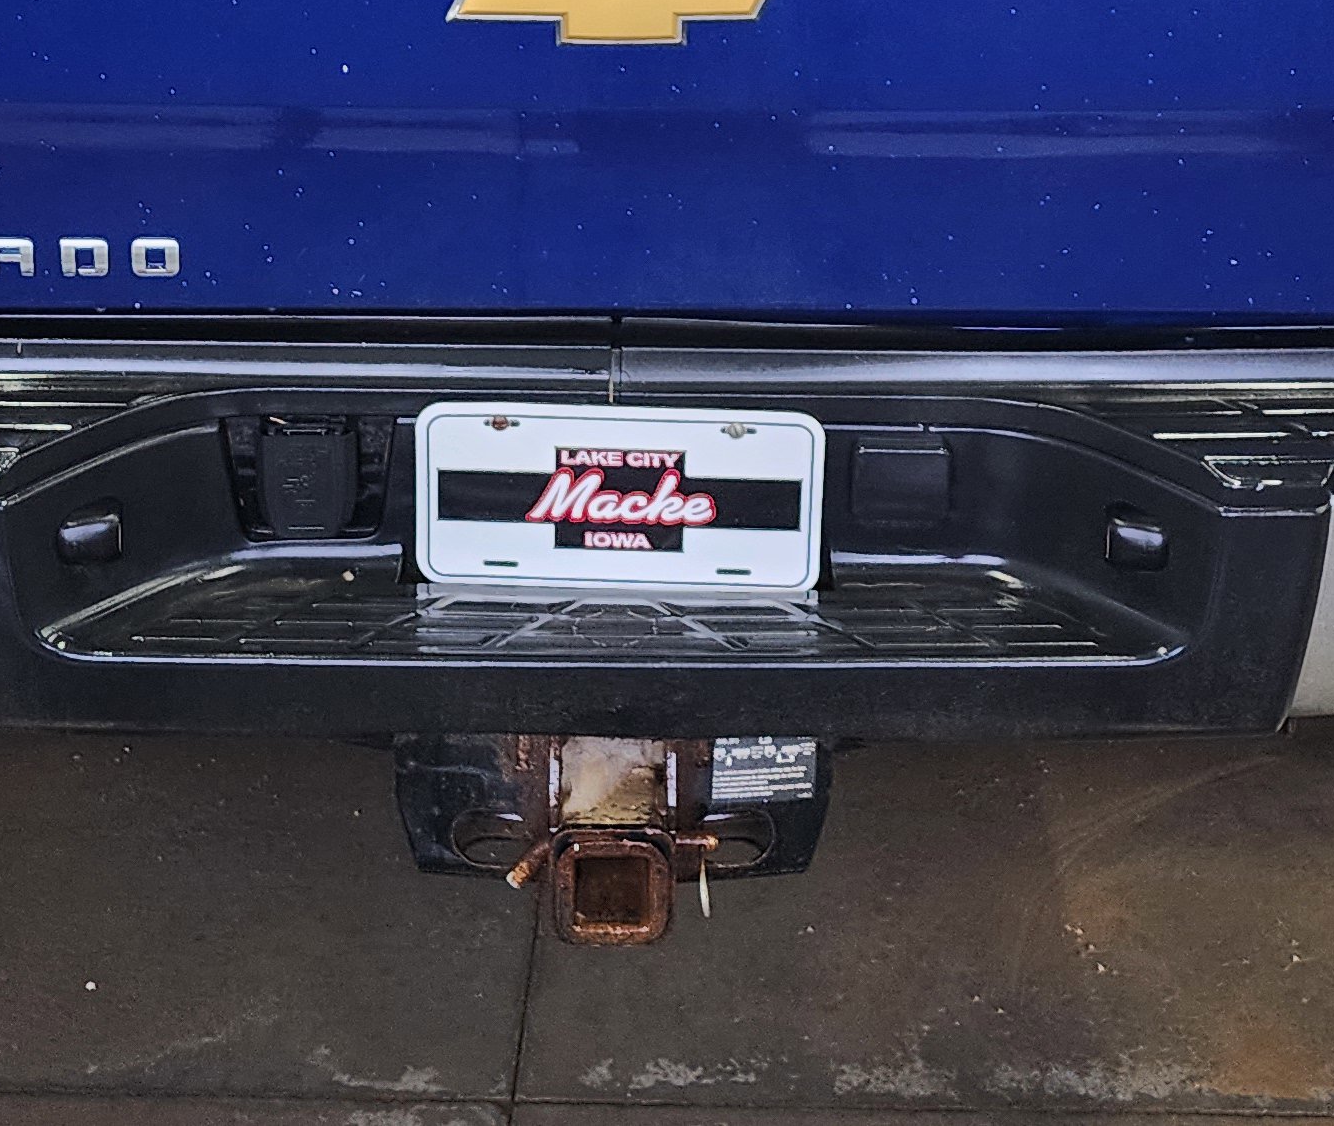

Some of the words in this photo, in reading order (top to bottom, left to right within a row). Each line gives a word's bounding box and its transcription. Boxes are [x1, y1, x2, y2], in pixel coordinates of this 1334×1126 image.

[560, 450, 624, 467] LAKE
[626, 451, 681, 469] CITY
[525, 468, 716, 525] Macke
[584, 531, 652, 549] IOWA
